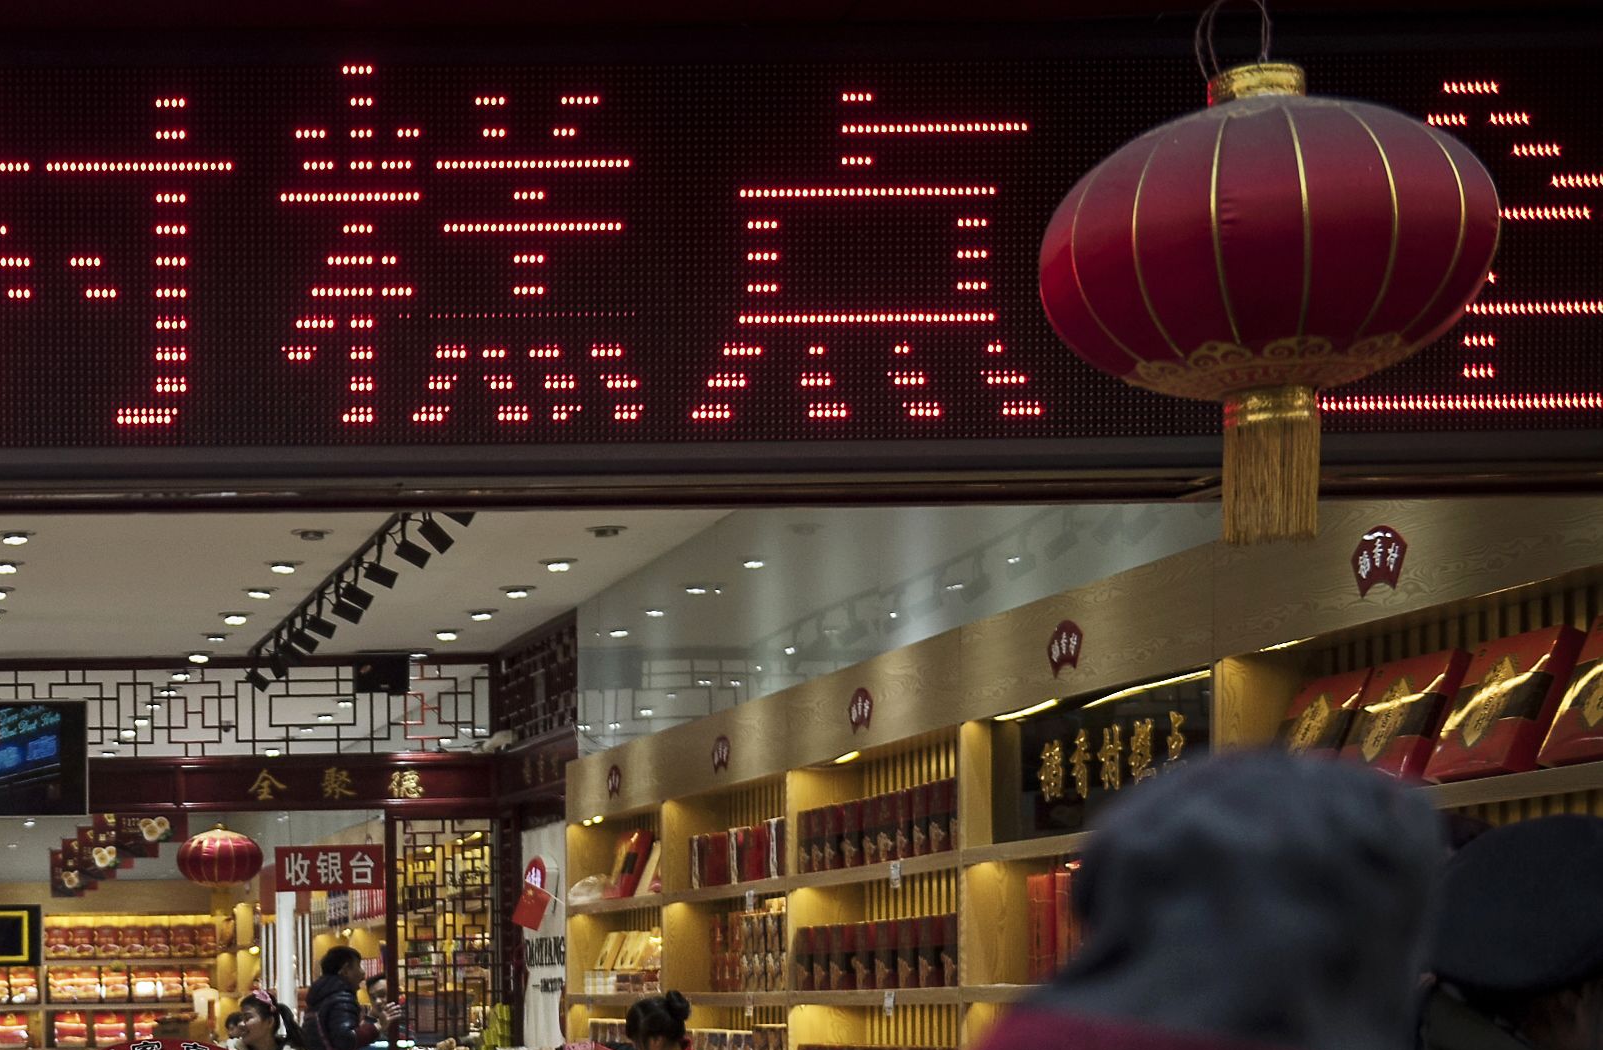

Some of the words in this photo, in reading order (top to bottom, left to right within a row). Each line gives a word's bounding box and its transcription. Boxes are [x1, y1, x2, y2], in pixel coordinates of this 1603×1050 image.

[248, 767, 426, 800] 全聚德
[284, 850, 375, 887] 收银台
